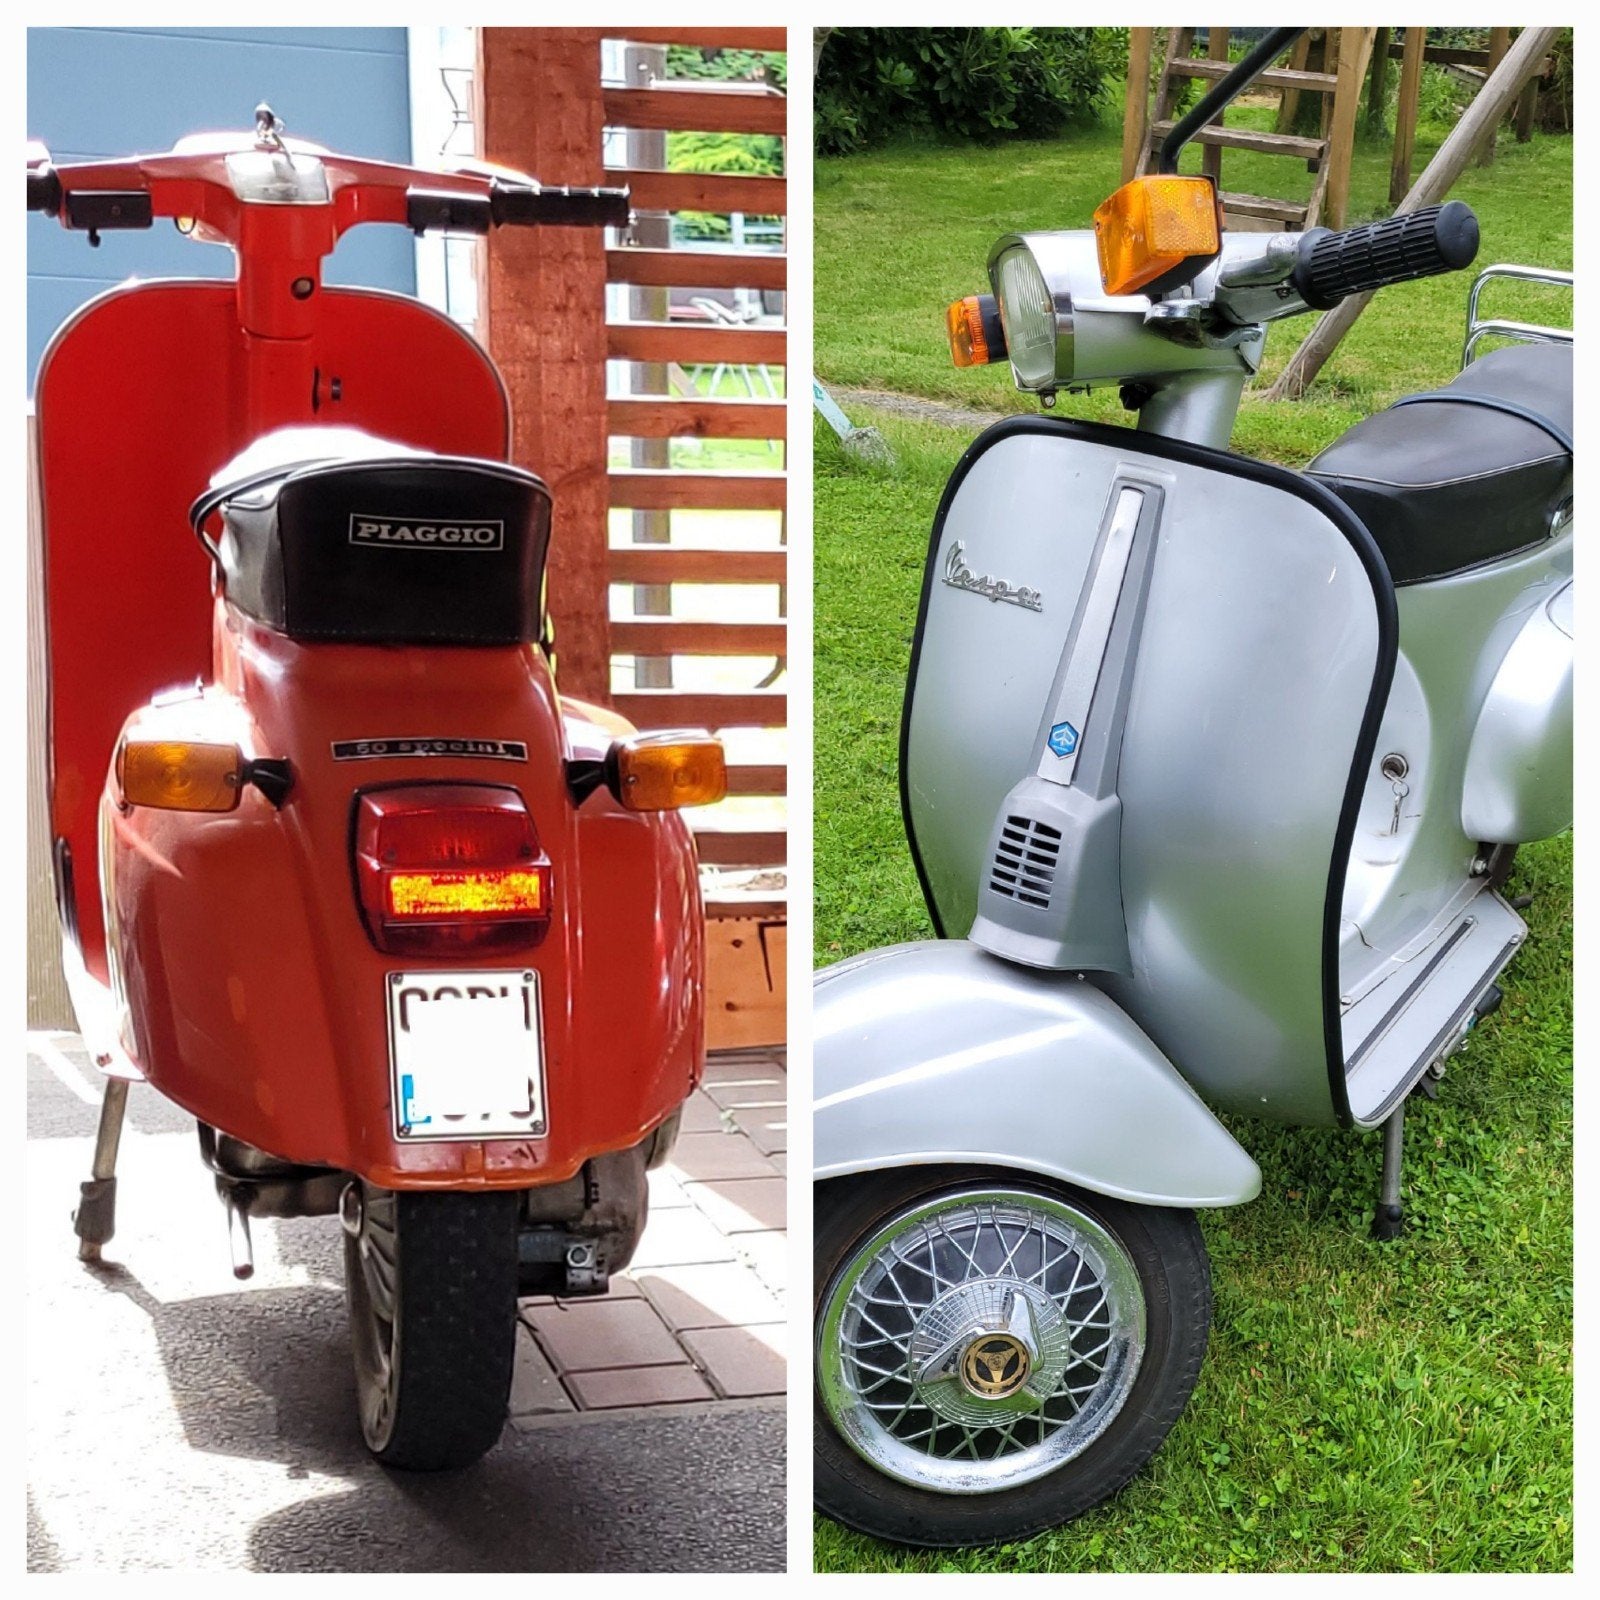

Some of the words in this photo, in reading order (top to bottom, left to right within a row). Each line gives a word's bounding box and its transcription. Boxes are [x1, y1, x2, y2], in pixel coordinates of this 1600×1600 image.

[356, 521, 496, 544] PIAGGIO
[942, 539, 1043, 613] Vespa
[356, 742, 388, 755] 50
